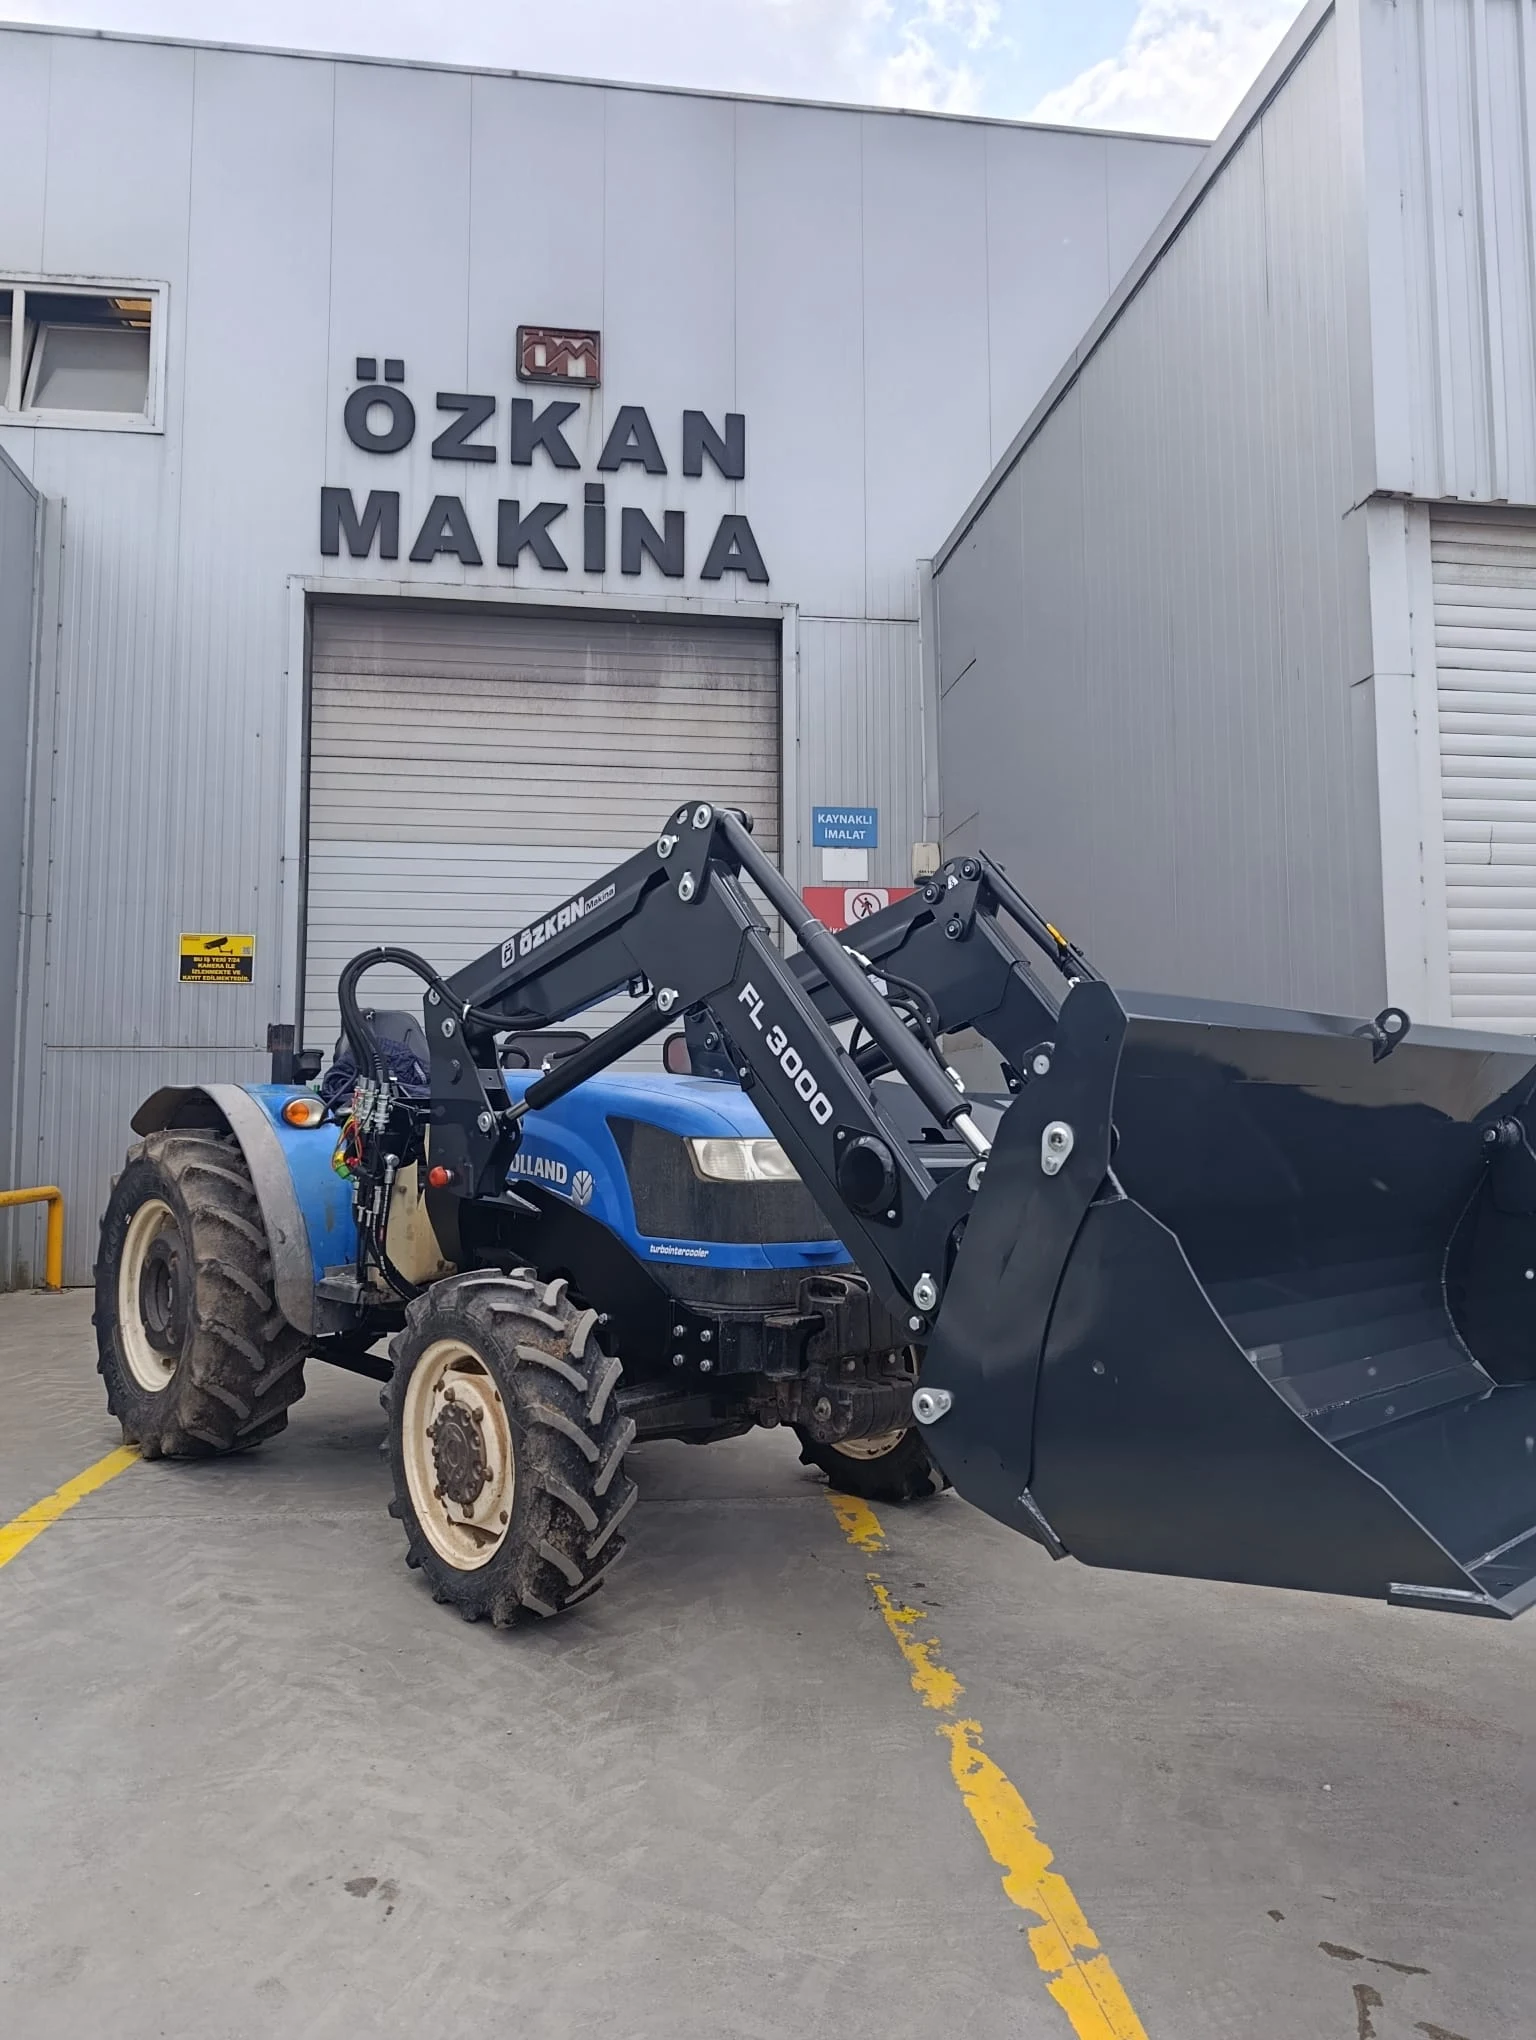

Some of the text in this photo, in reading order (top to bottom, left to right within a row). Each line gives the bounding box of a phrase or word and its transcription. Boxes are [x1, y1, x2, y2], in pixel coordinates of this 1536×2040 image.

[344, 357, 745, 479] ÖZKAN
[320, 482, 769, 584] MAKİNA
[817, 813, 873, 825] KAYNAKLI
[824, 827, 867, 840] İMALAT
[519, 896, 585, 957] ÖZKAN
[585, 887, 615, 912] Makina
[738, 981, 834, 1126] FL 3000
[510, 1153, 568, 1185] OLLAND
[649, 1243, 710, 1258] turbointercooler
